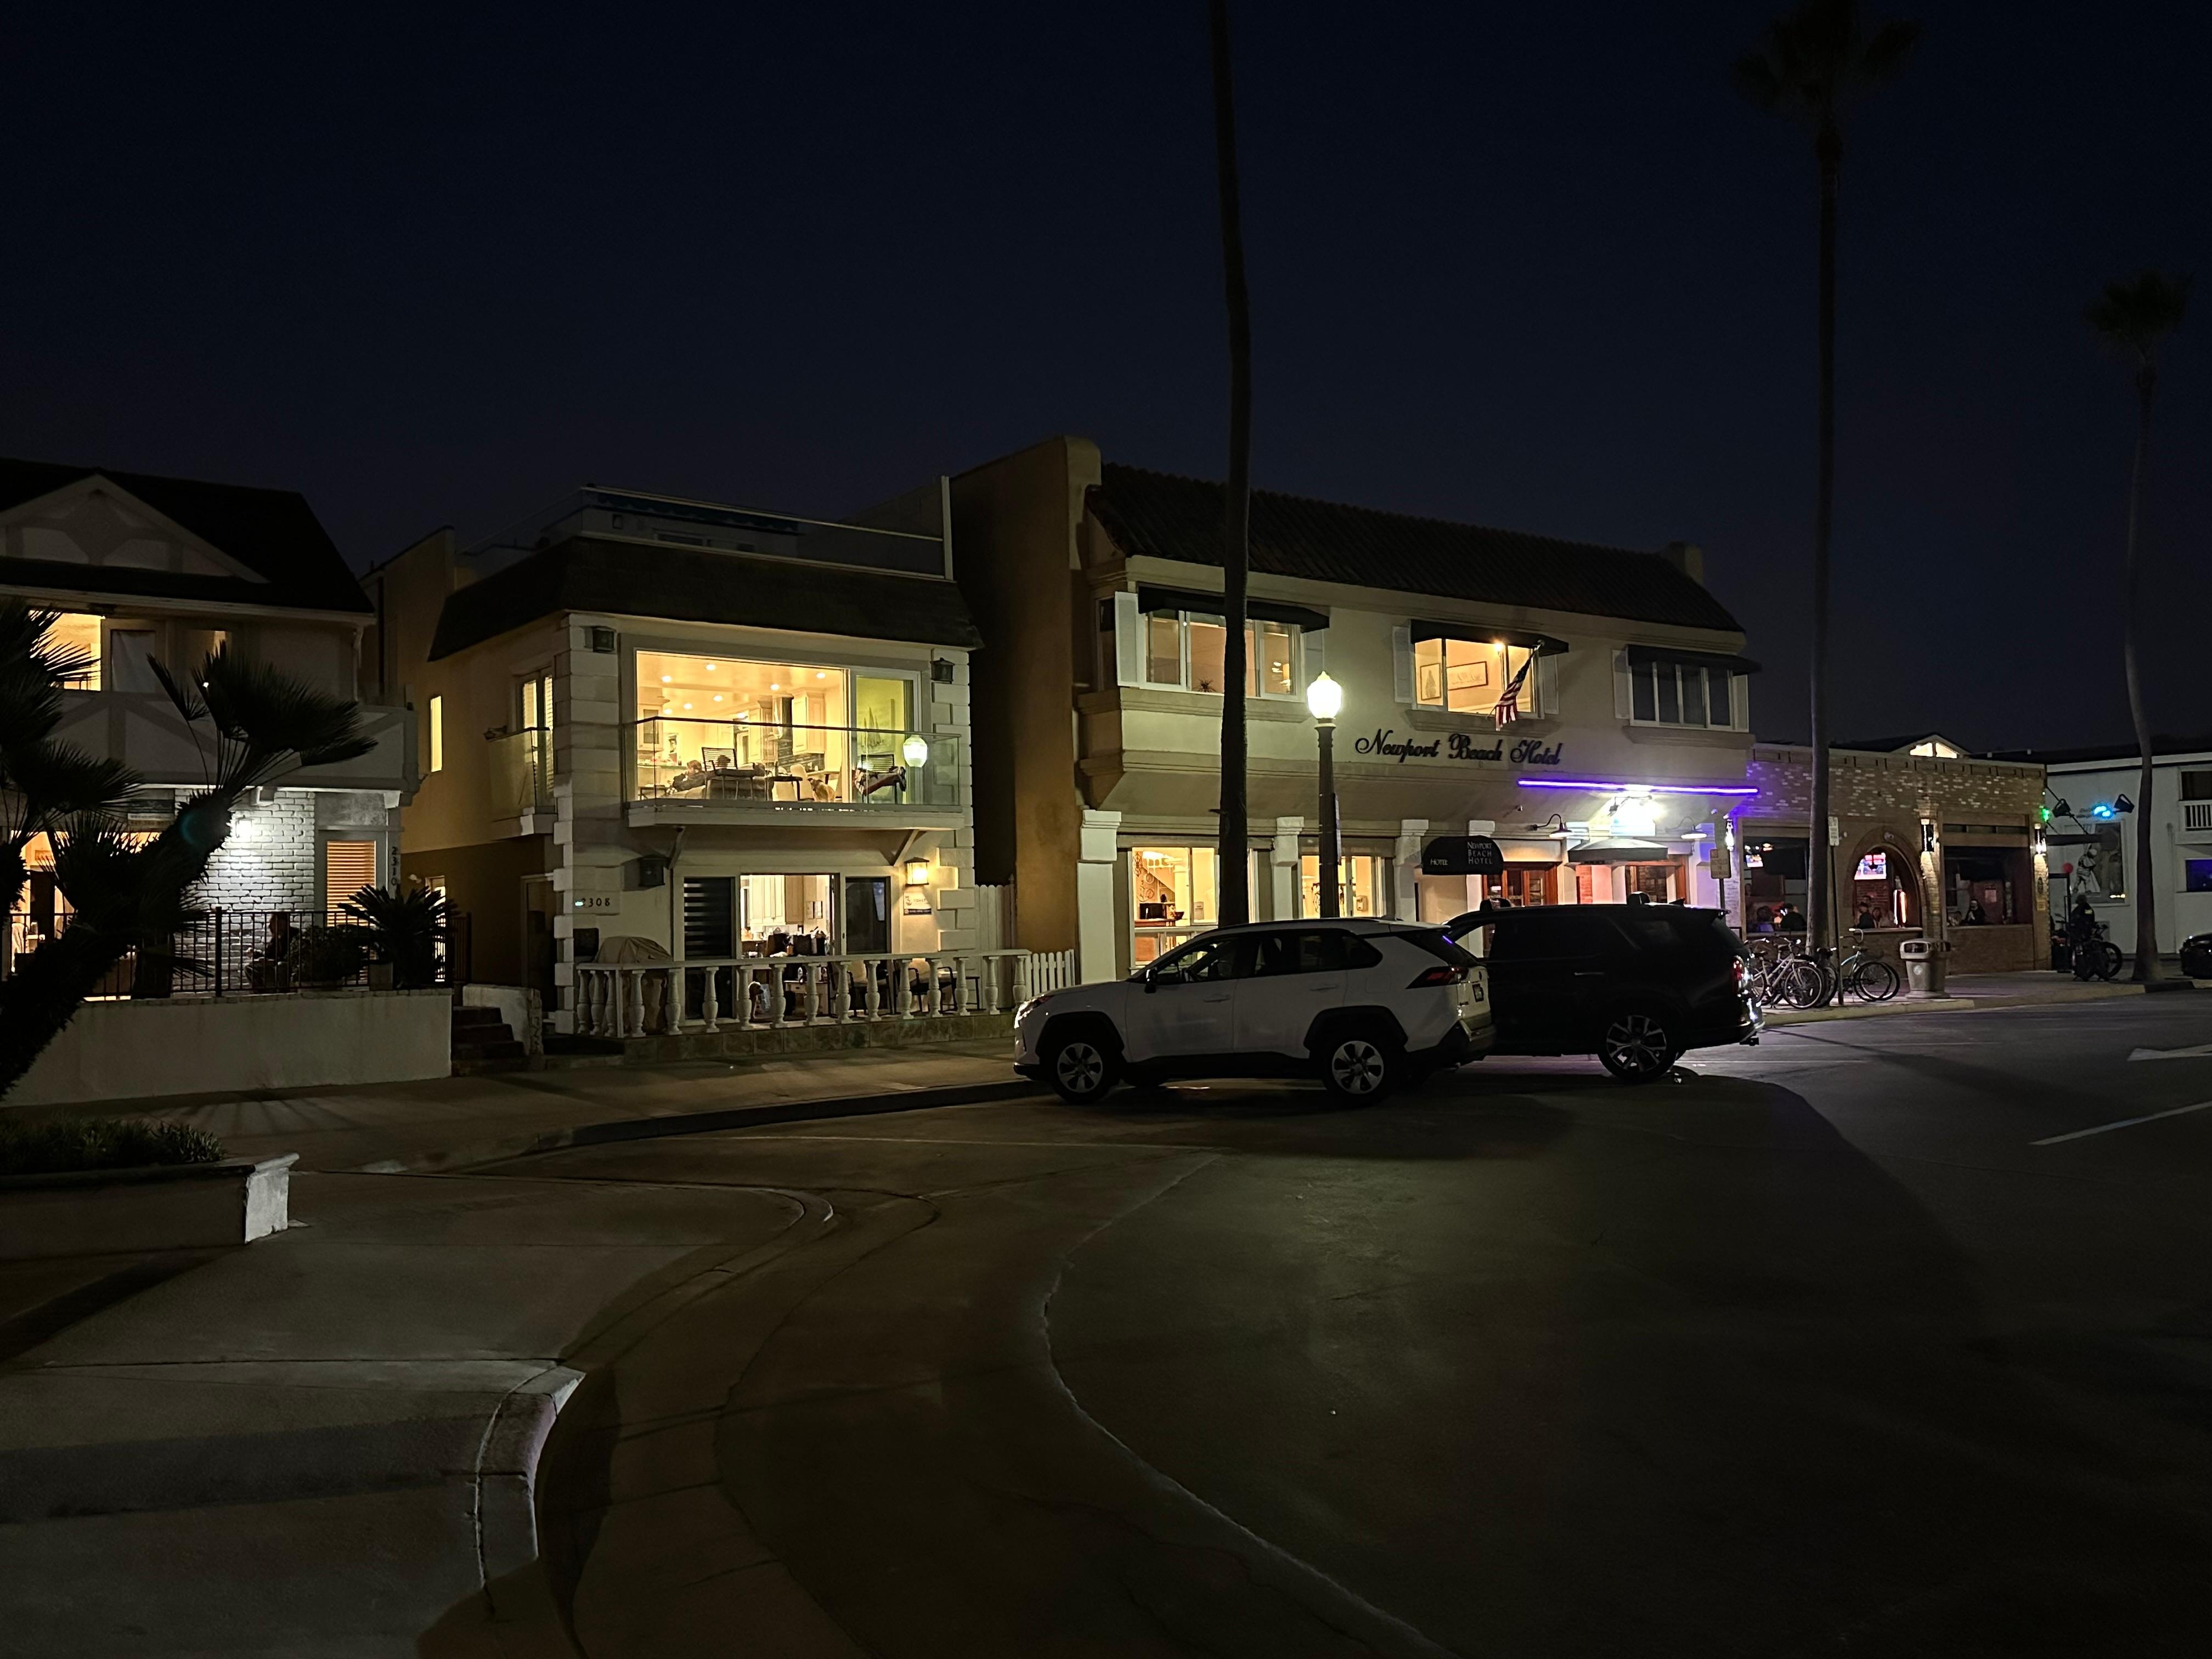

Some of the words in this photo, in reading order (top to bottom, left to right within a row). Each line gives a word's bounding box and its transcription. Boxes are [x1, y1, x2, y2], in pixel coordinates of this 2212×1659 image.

[1355, 729, 1441, 763] Newport
[1448, 733, 1503, 761] Beach
[1510, 739, 1563, 765] Hotel
